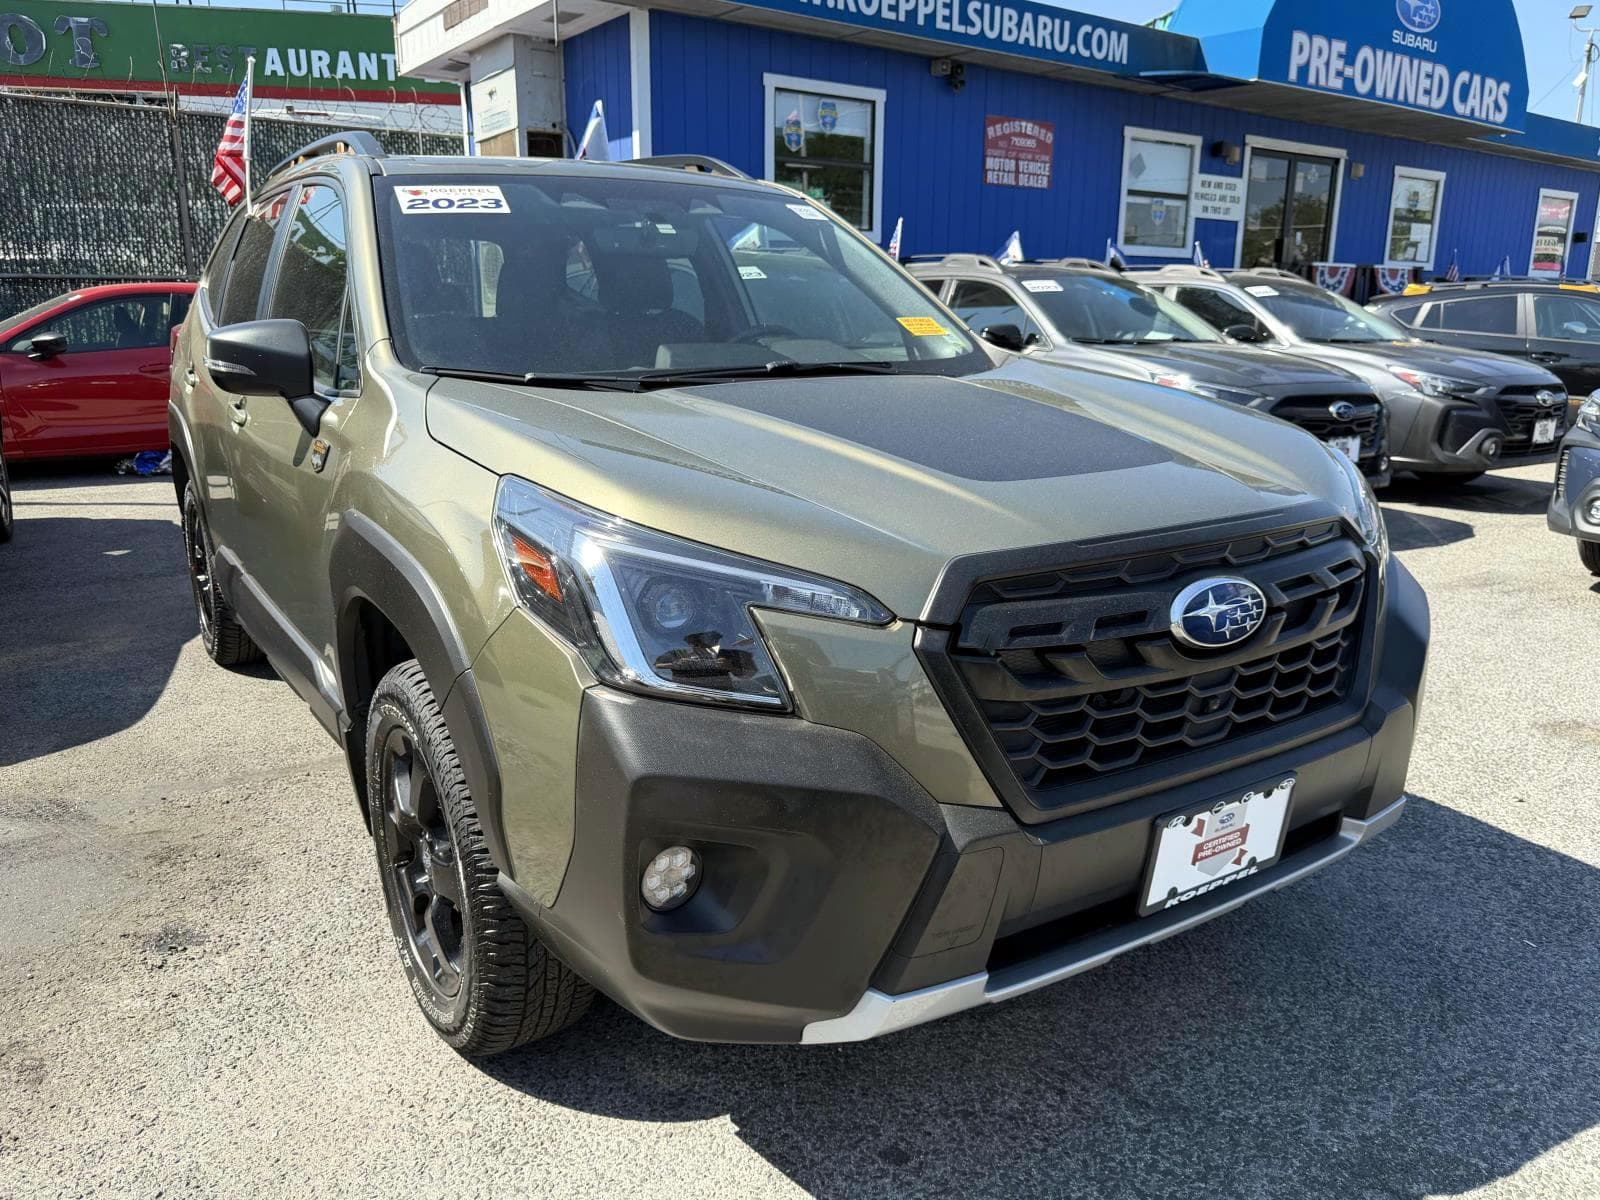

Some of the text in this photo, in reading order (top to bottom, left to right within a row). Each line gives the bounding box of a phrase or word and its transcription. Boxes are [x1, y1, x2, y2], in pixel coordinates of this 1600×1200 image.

[801, 0, 1128, 64] .EPPELSUBARU.COM
[1392, 29, 1437, 53] SUBARU
[1288, 30, 1511, 123] PRE-OWNED CARS
[987, 121, 1053, 144] REGISTERED
[986, 157, 1050, 175] MOTOR VEHICLE
[987, 171, 1048, 188] RETAIL DEALER
[406, 198, 503, 209] 2023
[1198, 838, 1242, 859] PRE-OWNED
[1203, 831, 1240, 850] CERTIFIED
[1165, 866, 1258, 908] KOEPPEL
